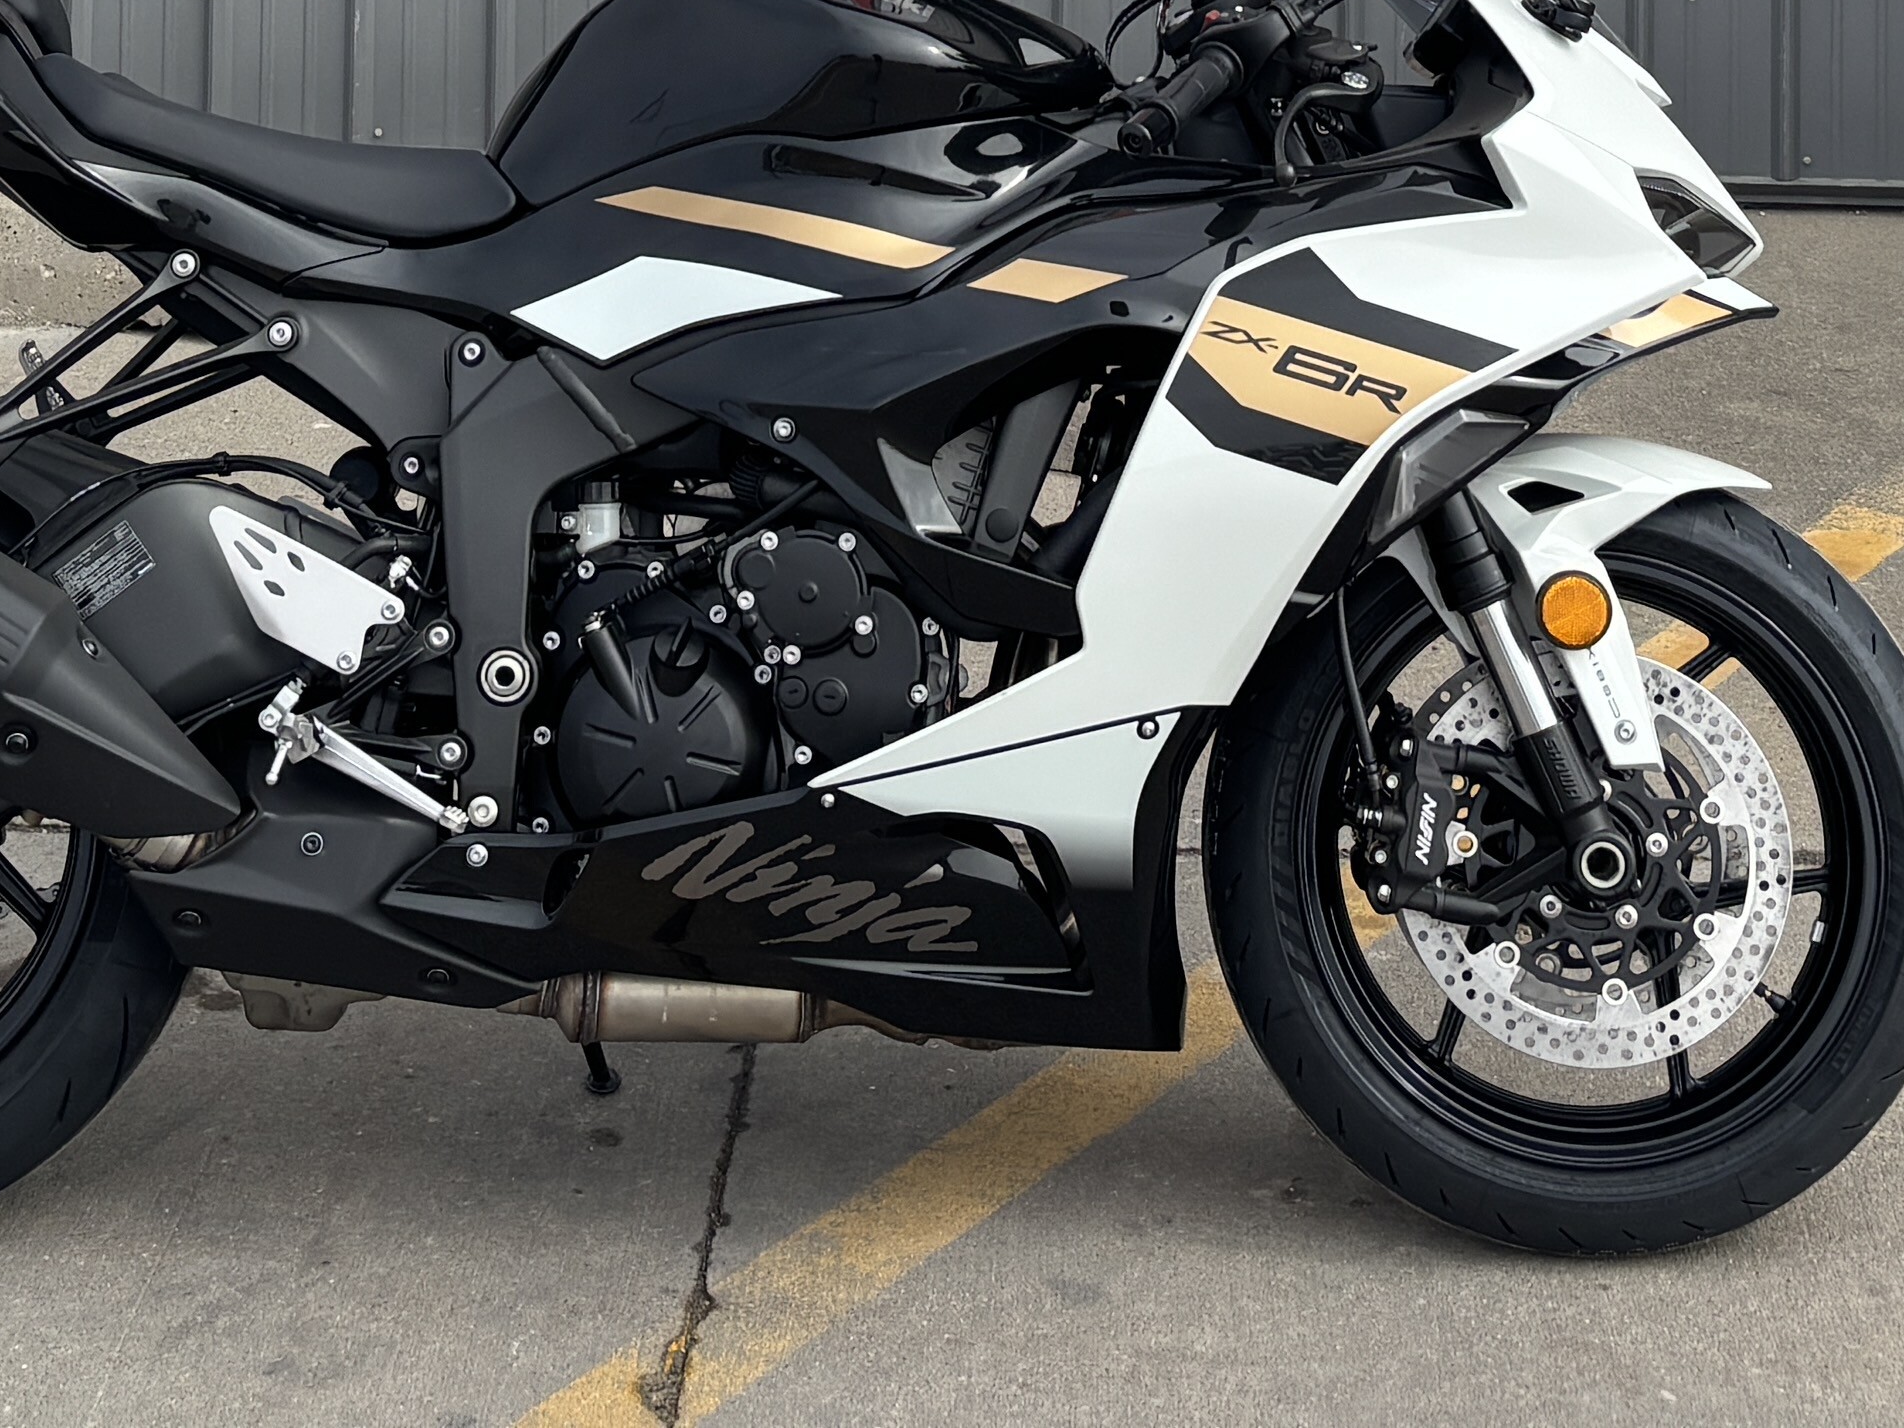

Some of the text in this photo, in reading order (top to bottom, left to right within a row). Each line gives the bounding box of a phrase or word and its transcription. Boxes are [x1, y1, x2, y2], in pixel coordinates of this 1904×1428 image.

[1199, 320, 1408, 415] ZX-6R
[1545, 738, 1582, 802] SHOWA
[1414, 792, 1437, 865] NISSIN
[640, 820, 978, 951] Ninja
